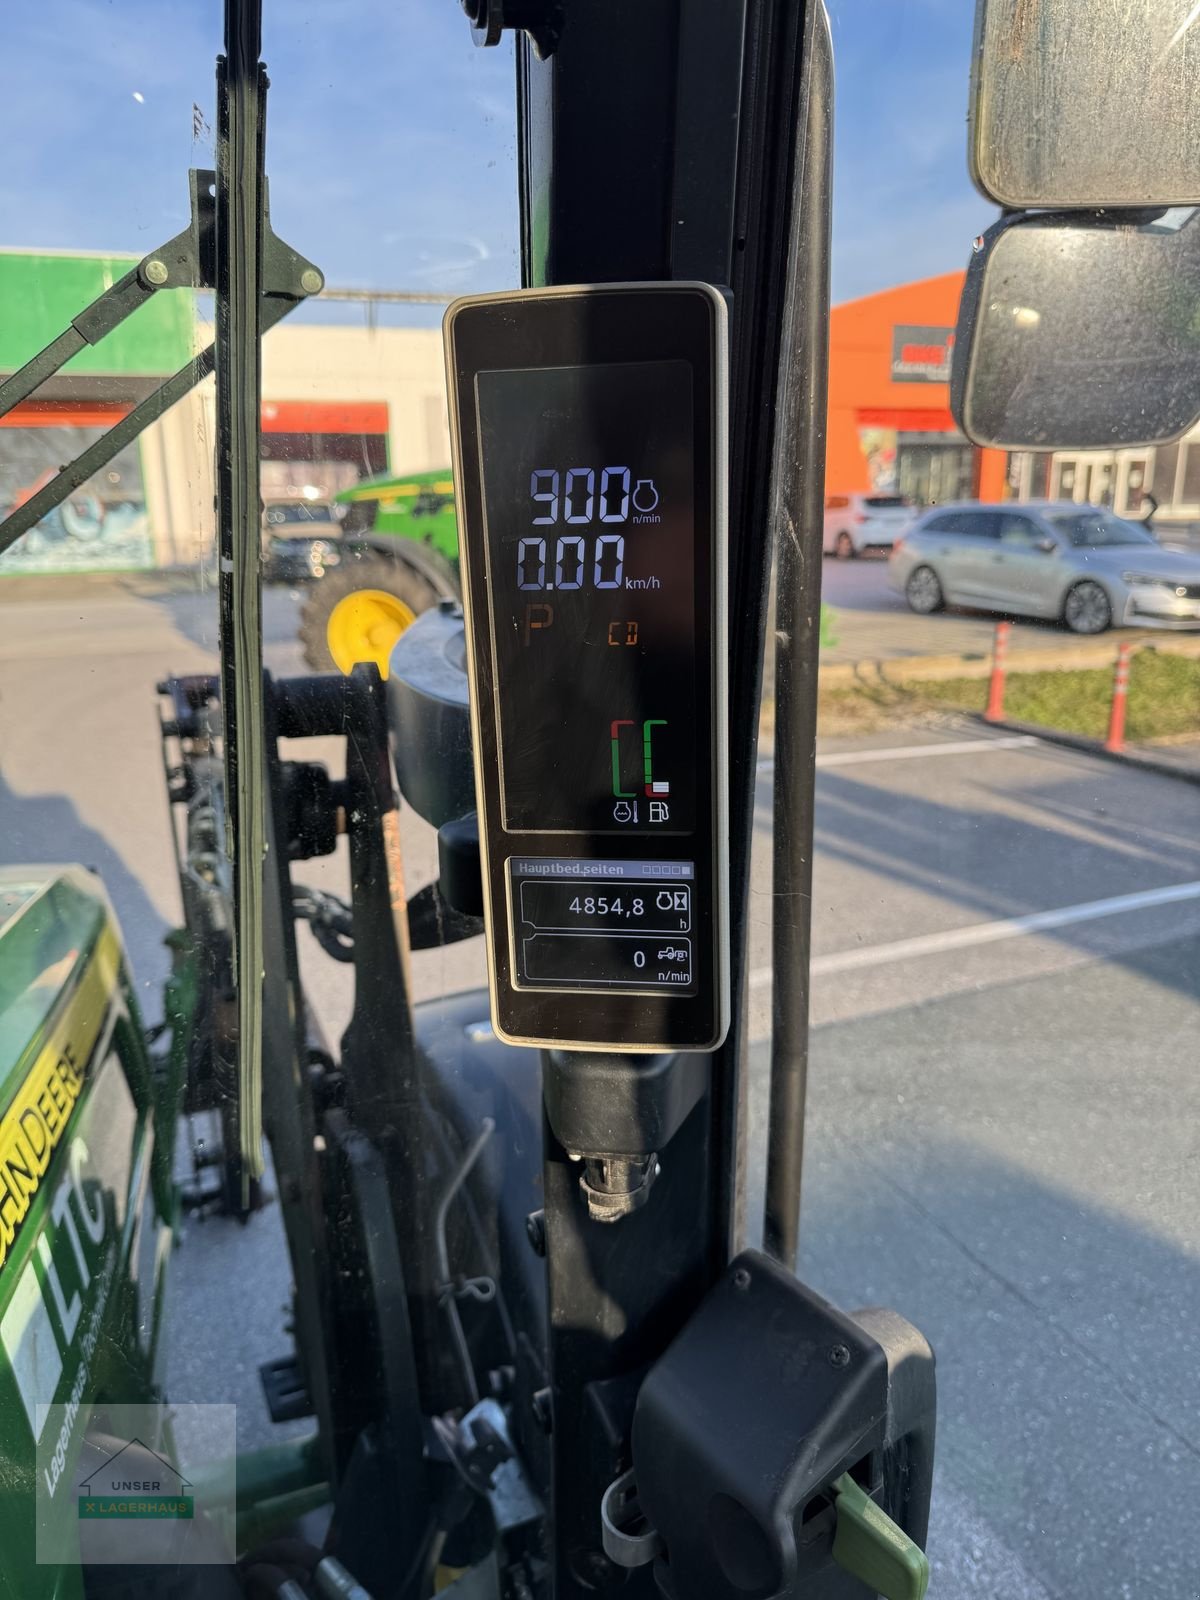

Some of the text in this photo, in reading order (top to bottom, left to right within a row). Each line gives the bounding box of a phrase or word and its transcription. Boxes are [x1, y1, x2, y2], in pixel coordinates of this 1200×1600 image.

[530, 466, 661, 525] 900 n/min
[517, 535, 661, 591] 0.00 km/h
[523, 603, 554, 647] P
[518, 862, 625, 877] Hauptbed.seiten
[569, 896, 645, 918] 4854,8
[679, 918, 688, 930] h
[633, 950, 646, 968] 0
[658, 970, 691, 982] n/min
[18, 1042, 84, 1163] DEERE
[44, 1361, 88, 1499] Lagerhaus
